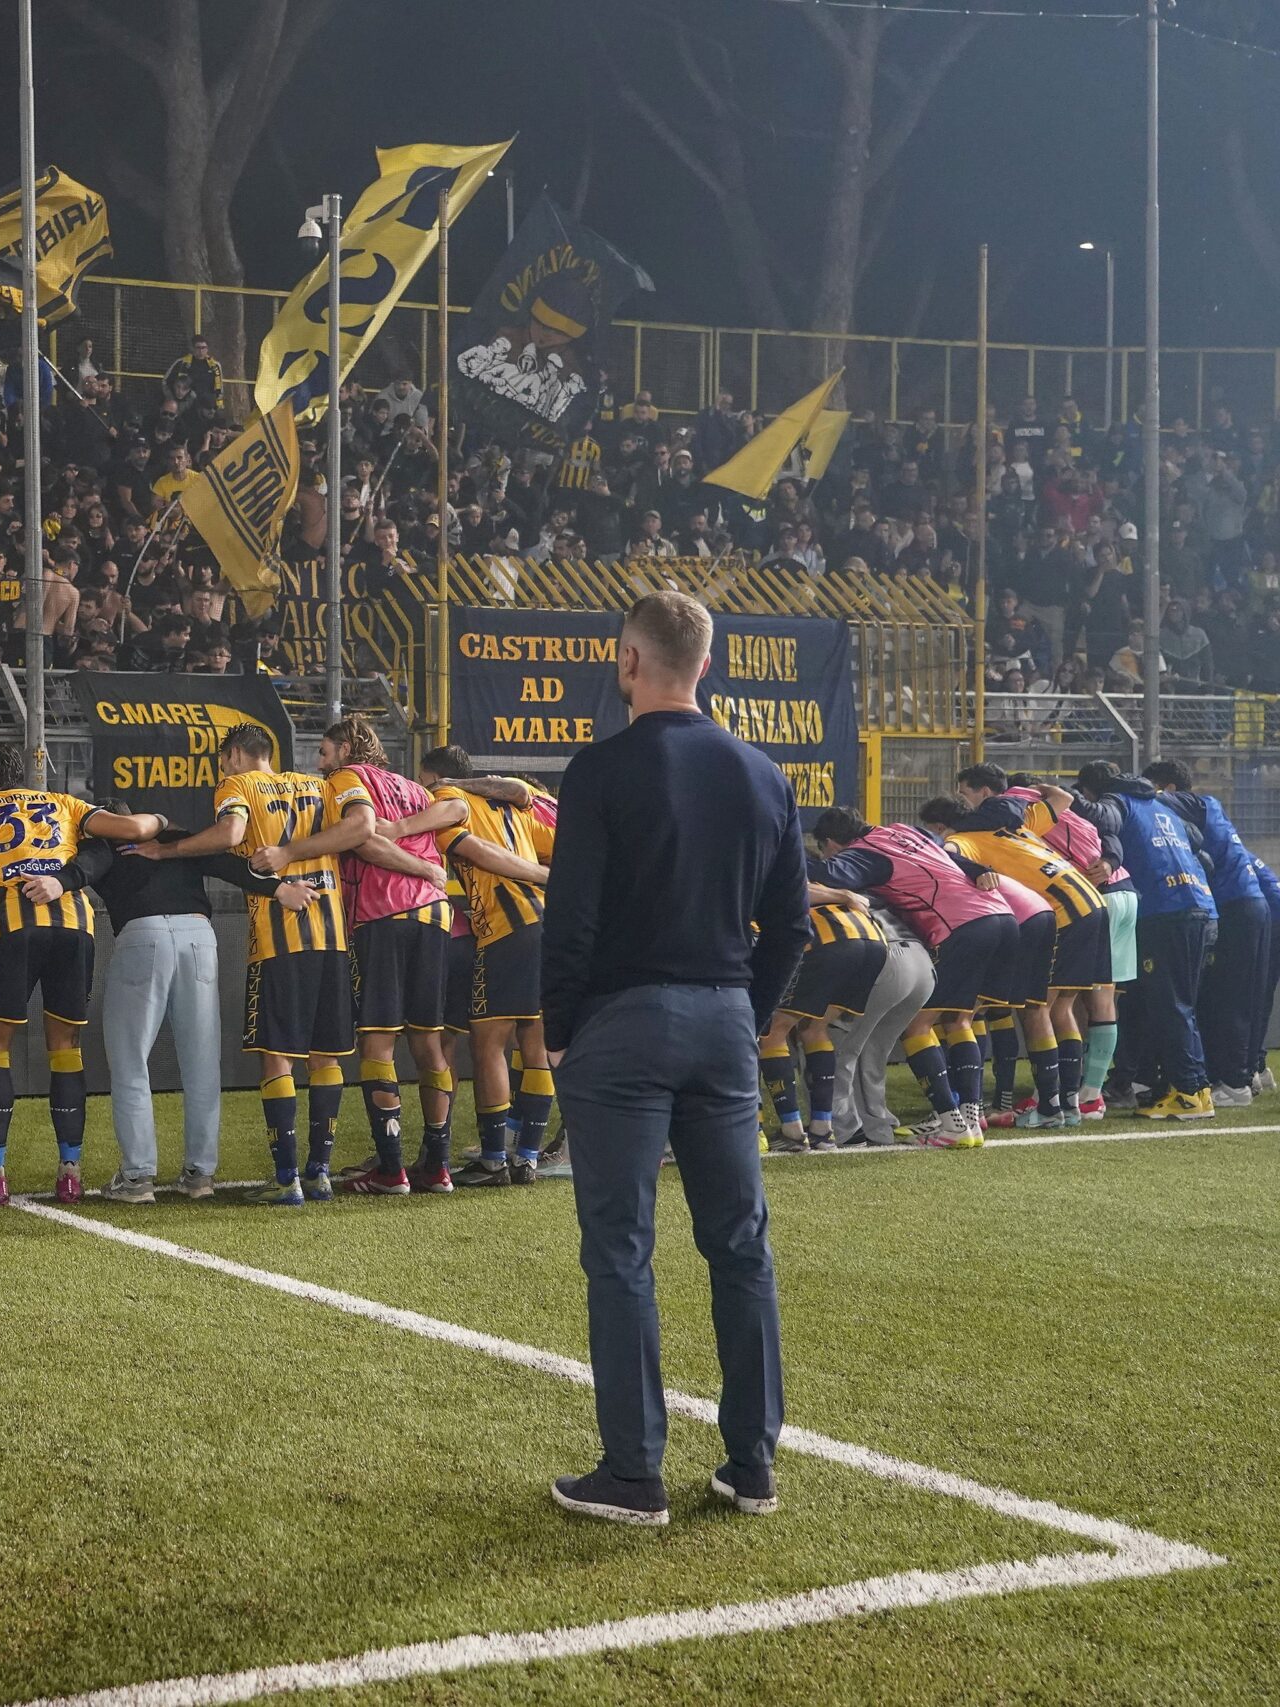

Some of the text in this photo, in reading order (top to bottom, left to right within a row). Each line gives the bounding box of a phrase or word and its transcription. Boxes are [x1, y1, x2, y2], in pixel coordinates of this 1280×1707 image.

[459, 633, 617, 663] CASTRUM
[727, 633, 797, 682] RIONE
[520, 676, 564, 702] AD
[96, 701, 210, 725] C.MARE
[710, 693, 824, 744] SCANZANO
[187, 726, 216, 754] DI
[493, 717, 593, 743] MARE
[113, 756, 216, 789] STABIA
[266, 795, 325, 848] 27
